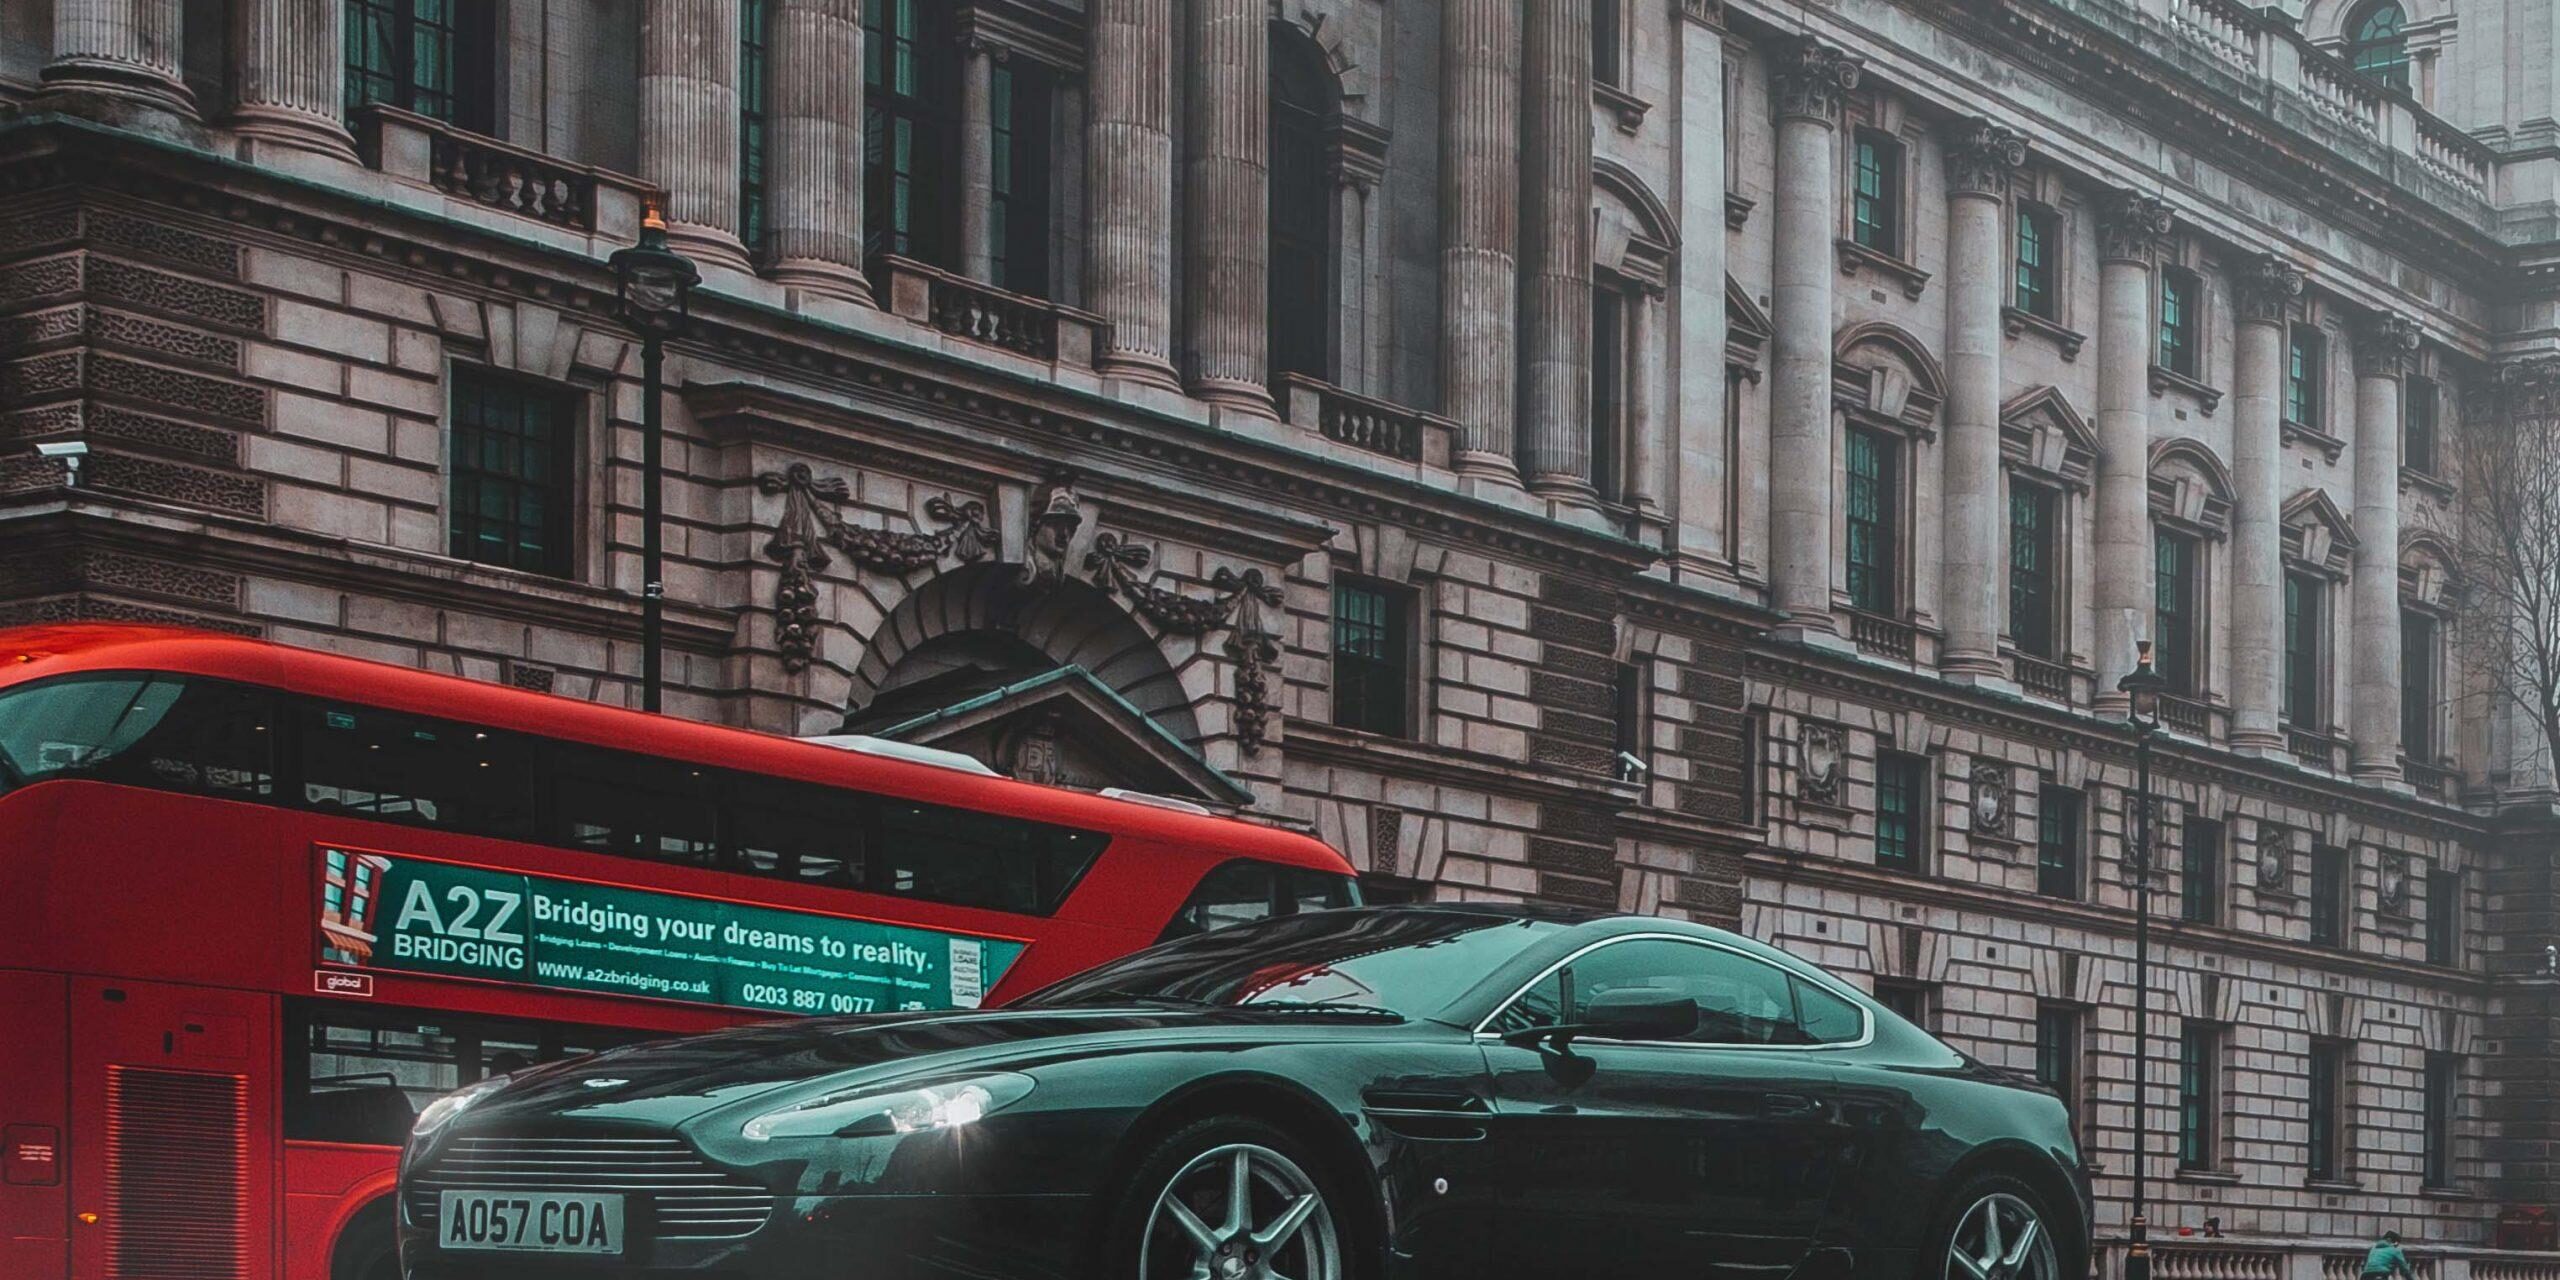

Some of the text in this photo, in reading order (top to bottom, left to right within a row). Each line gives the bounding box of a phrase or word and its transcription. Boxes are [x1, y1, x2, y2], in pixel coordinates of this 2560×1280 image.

[395, 880, 524, 944] A2Z
[394, 933, 525, 969] BRIDGING
[533, 894, 933, 973] Bridging your dreams to reality.
[537, 961, 711, 993] www.a2zbridging.co.uk
[742, 983, 788, 1006] 0203
[792, 988, 826, 1010] 887
[830, 993, 875, 1014] 0077
[539, 1201, 609, 1247] COA
